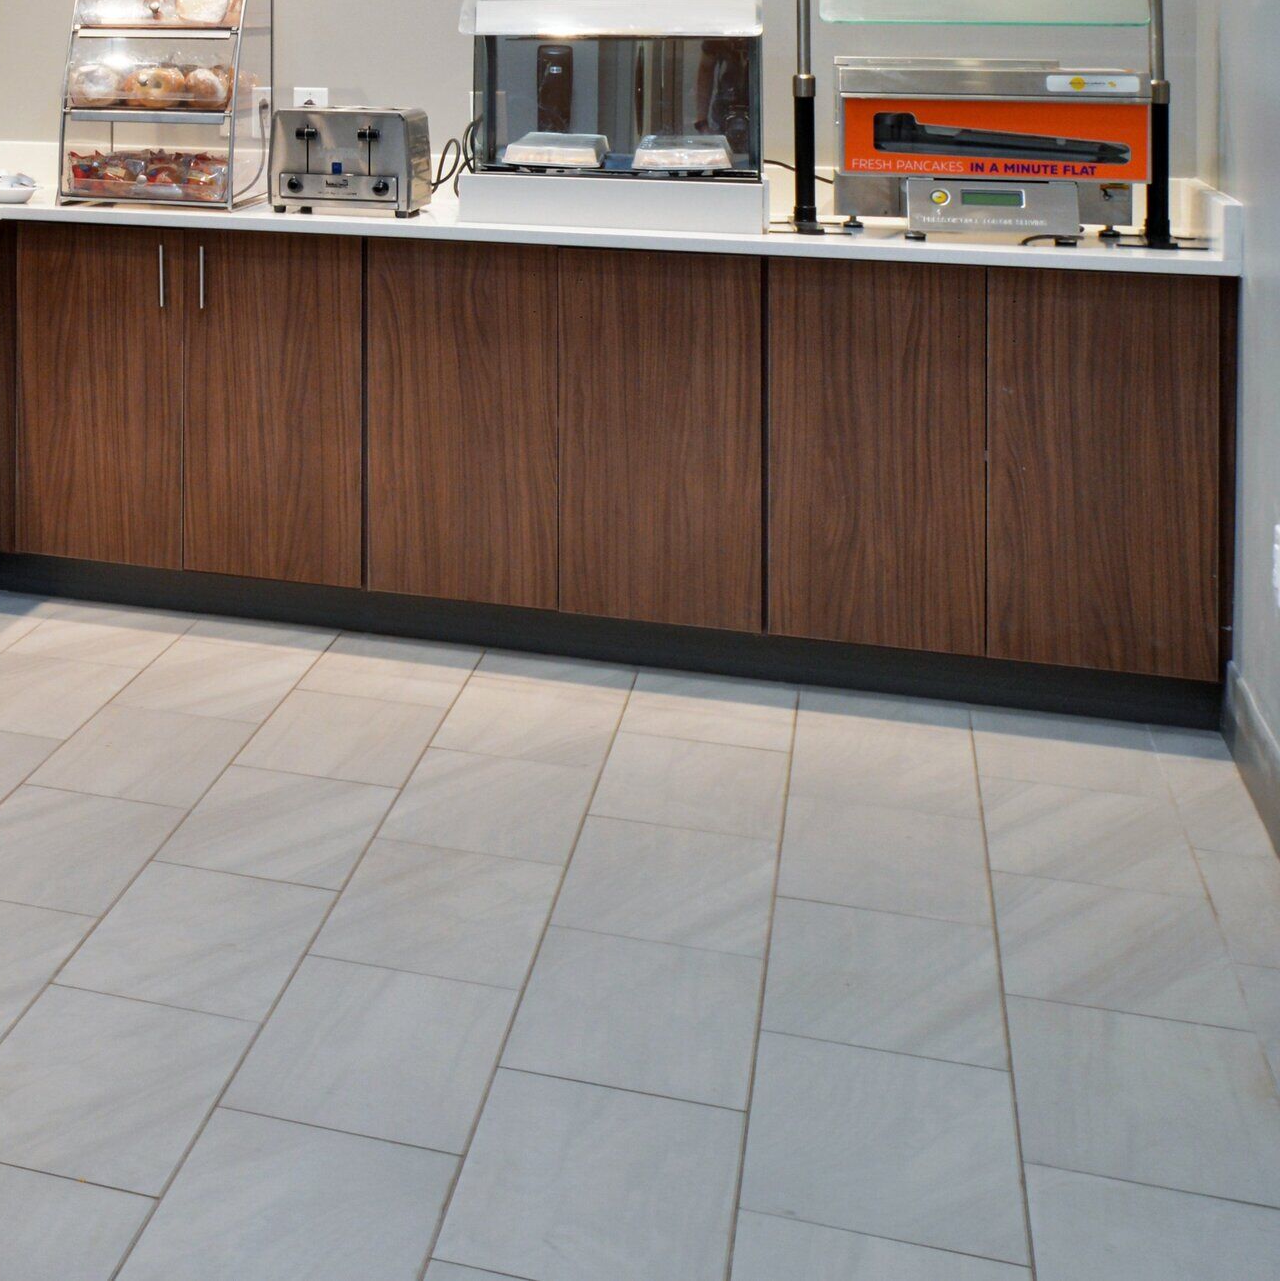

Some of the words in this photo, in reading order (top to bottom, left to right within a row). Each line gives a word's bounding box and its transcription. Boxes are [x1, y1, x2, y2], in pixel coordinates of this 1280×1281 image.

[851, 158, 892, 170] FRESH
[896, 159, 964, 172] PANCAKES
[970, 162, 984, 172] IN
[989, 163, 999, 173] A
[1003, 163, 1058, 175] MINUTE
[1063, 164, 1097, 175] FLAT
